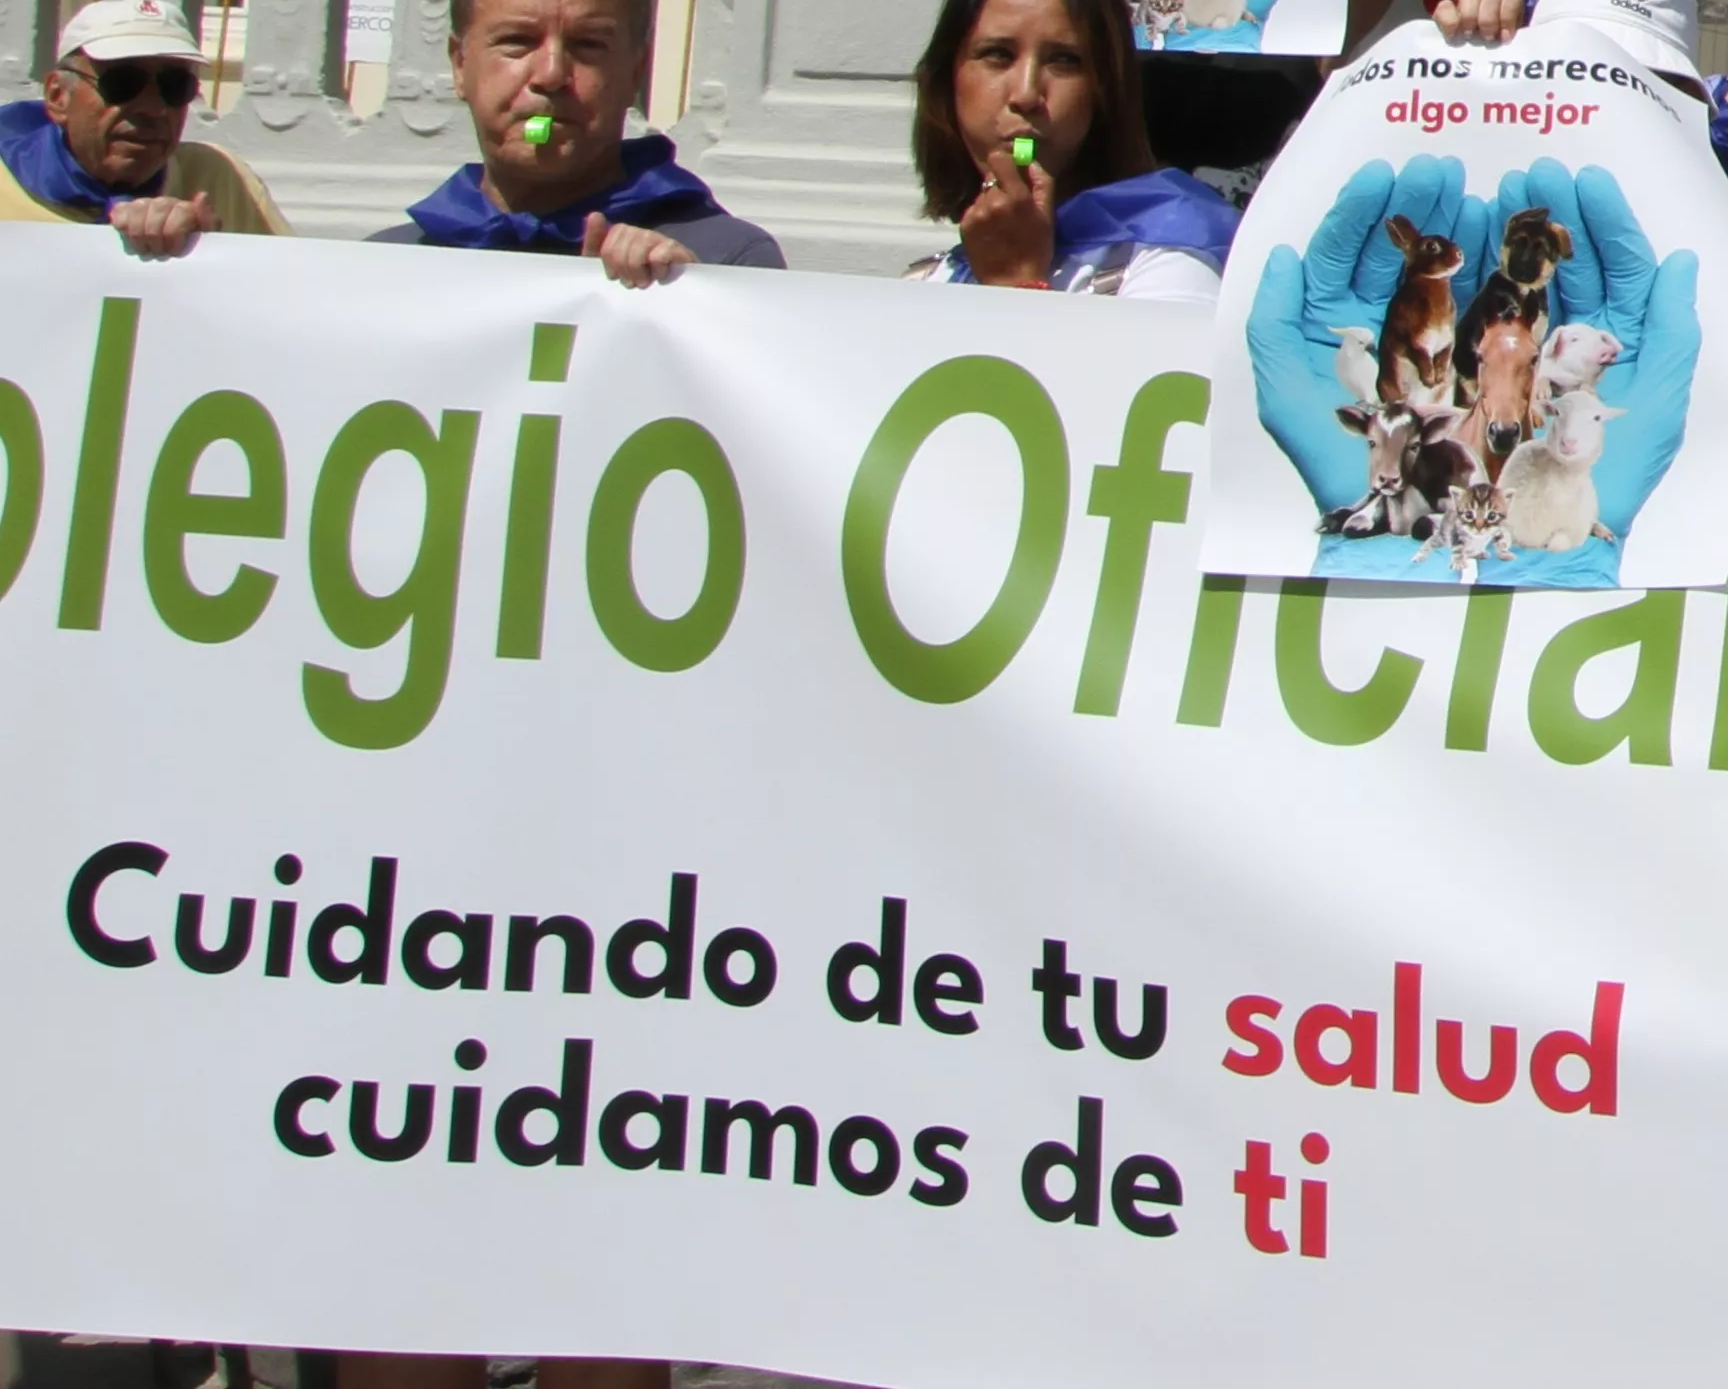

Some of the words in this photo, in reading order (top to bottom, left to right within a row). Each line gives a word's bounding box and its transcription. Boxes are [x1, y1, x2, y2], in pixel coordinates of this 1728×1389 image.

[1385, 89, 1468, 133] algo
[1483, 92, 1600, 135] mejor
[1407, 57, 1472, 78] nos
[0, 297, 746, 751] legio
[64, 841, 778, 1011] Cuidando
[826, 896, 985, 1037] de
[1031, 939, 1169, 1061] tu
[1222, 960, 1626, 1117] salud
[271, 1037, 970, 1207] cuidamos
[1020, 1098, 1185, 1239] de
[1232, 1133, 1331, 1260] ti
